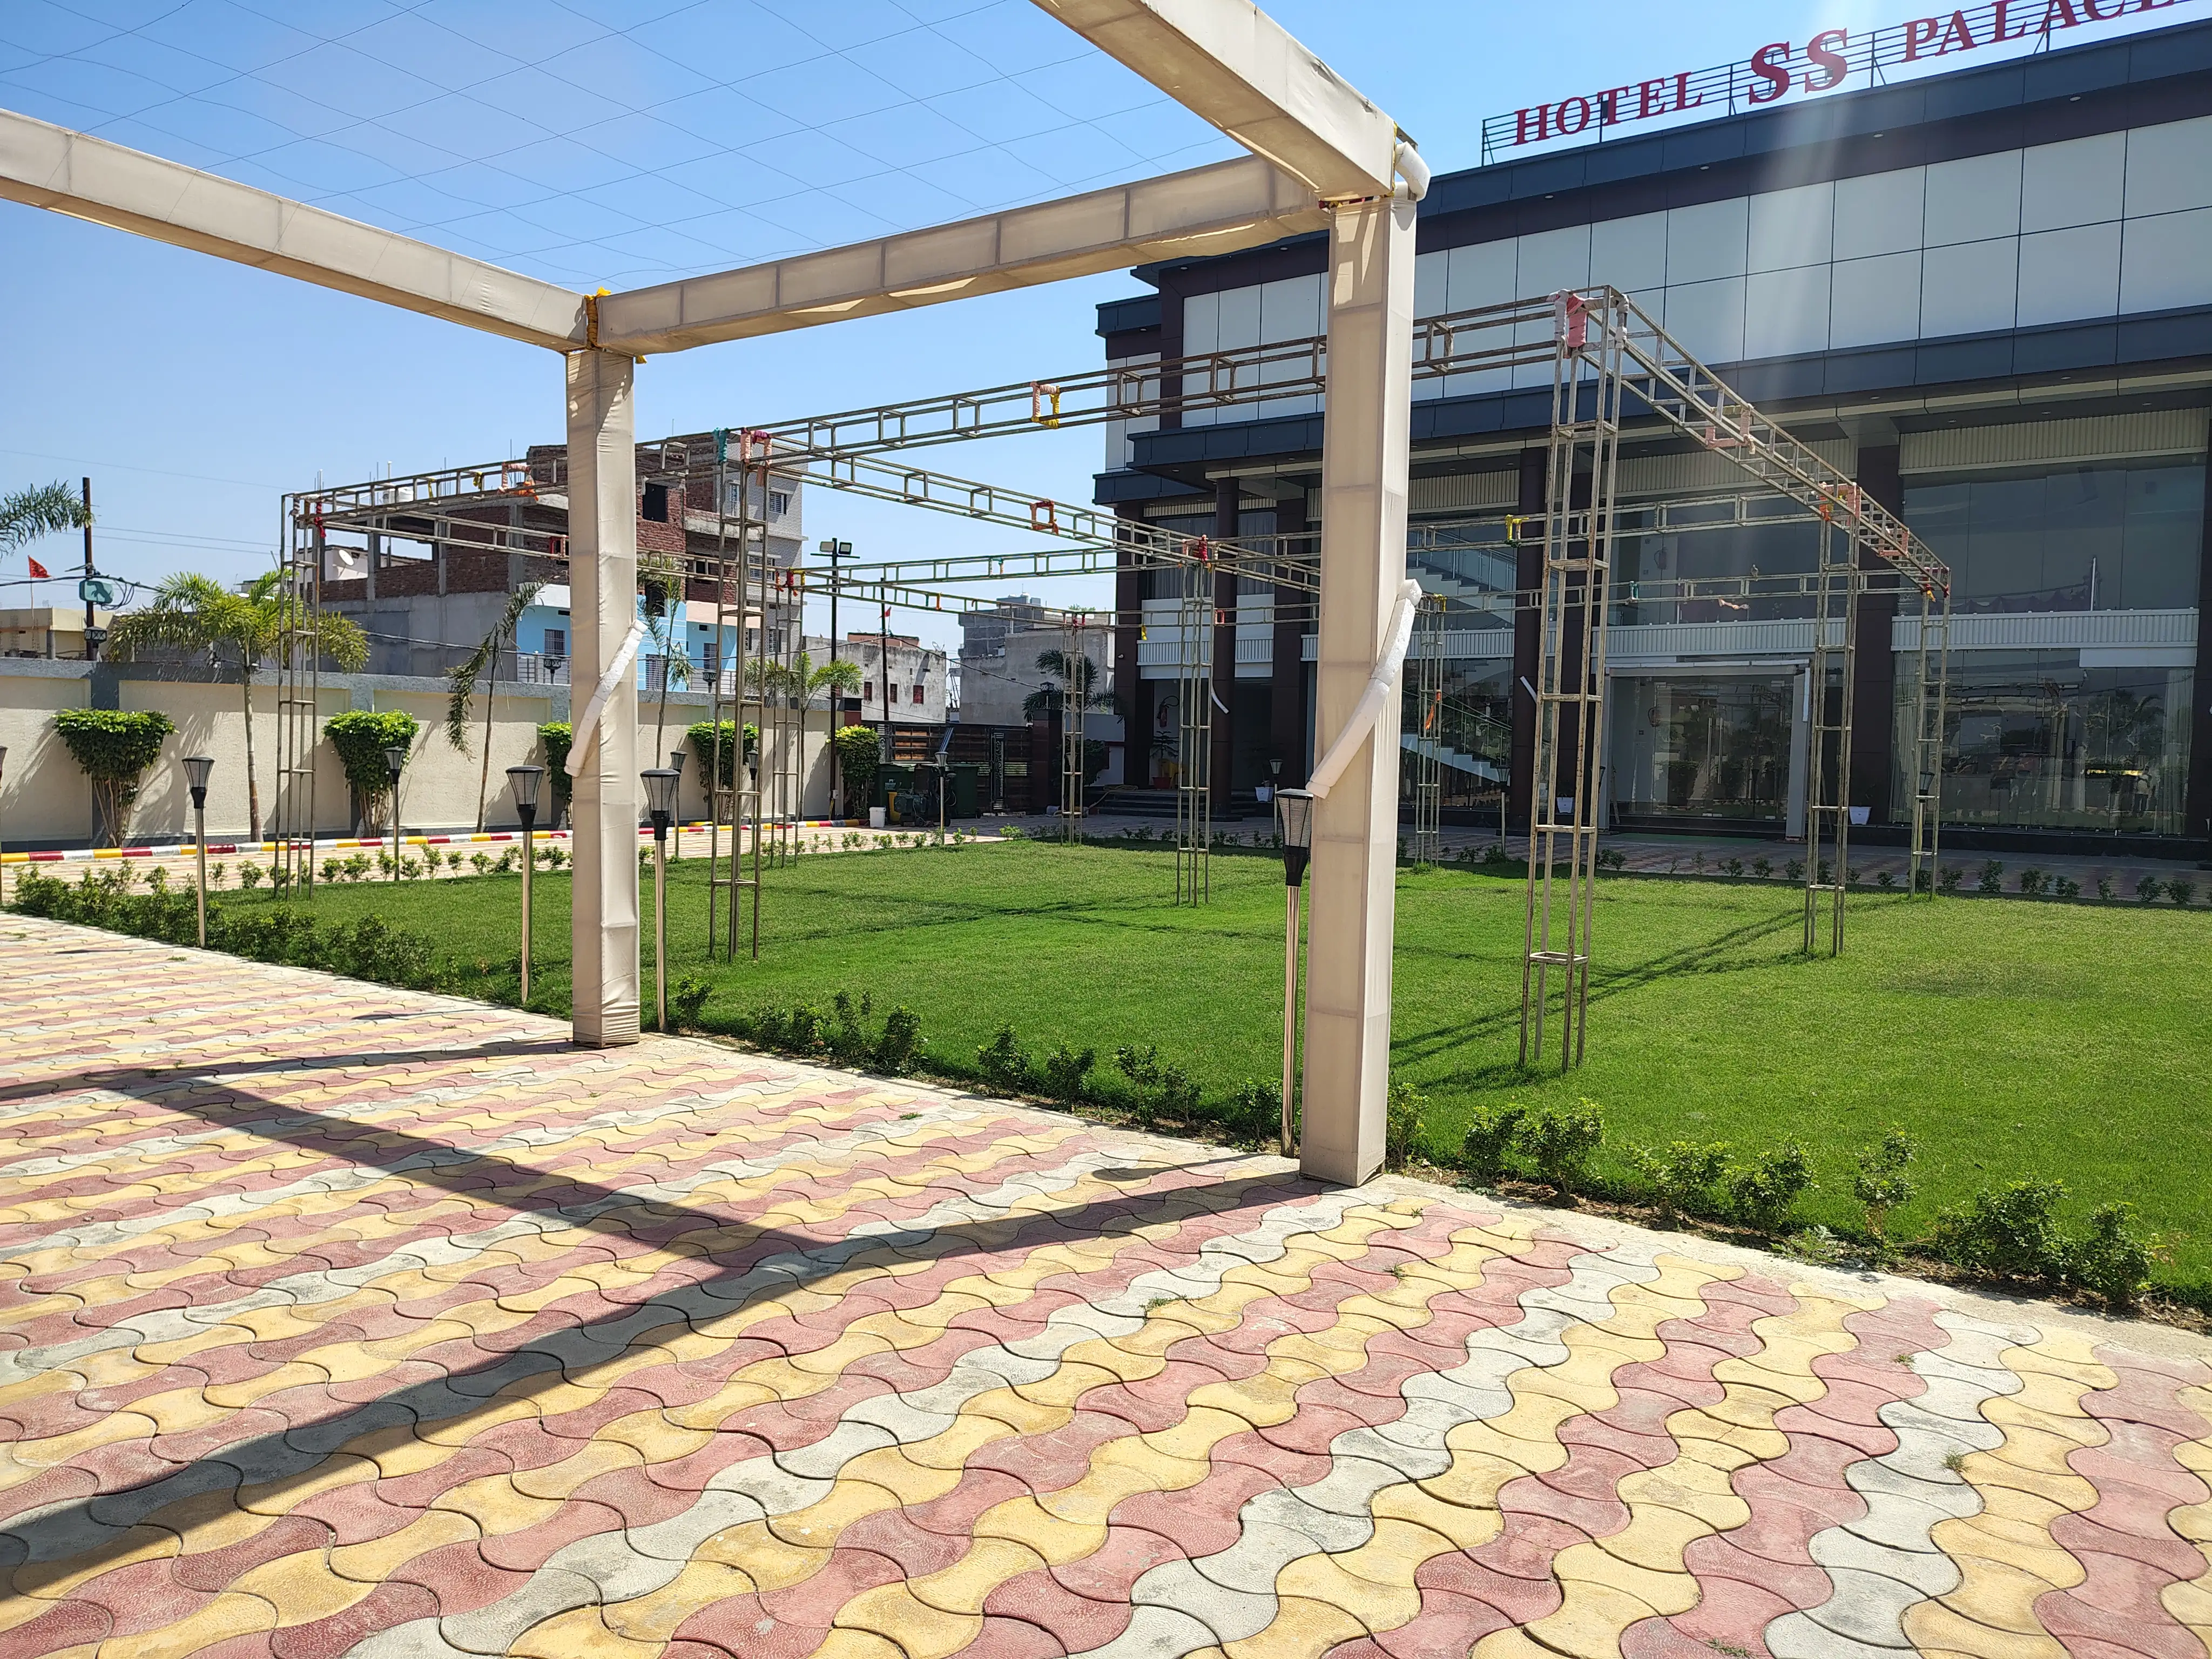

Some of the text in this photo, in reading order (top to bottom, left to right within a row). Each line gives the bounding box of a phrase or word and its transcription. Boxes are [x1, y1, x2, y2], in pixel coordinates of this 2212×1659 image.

[1512, 0, 2174, 146] HOTEL SS PALA
